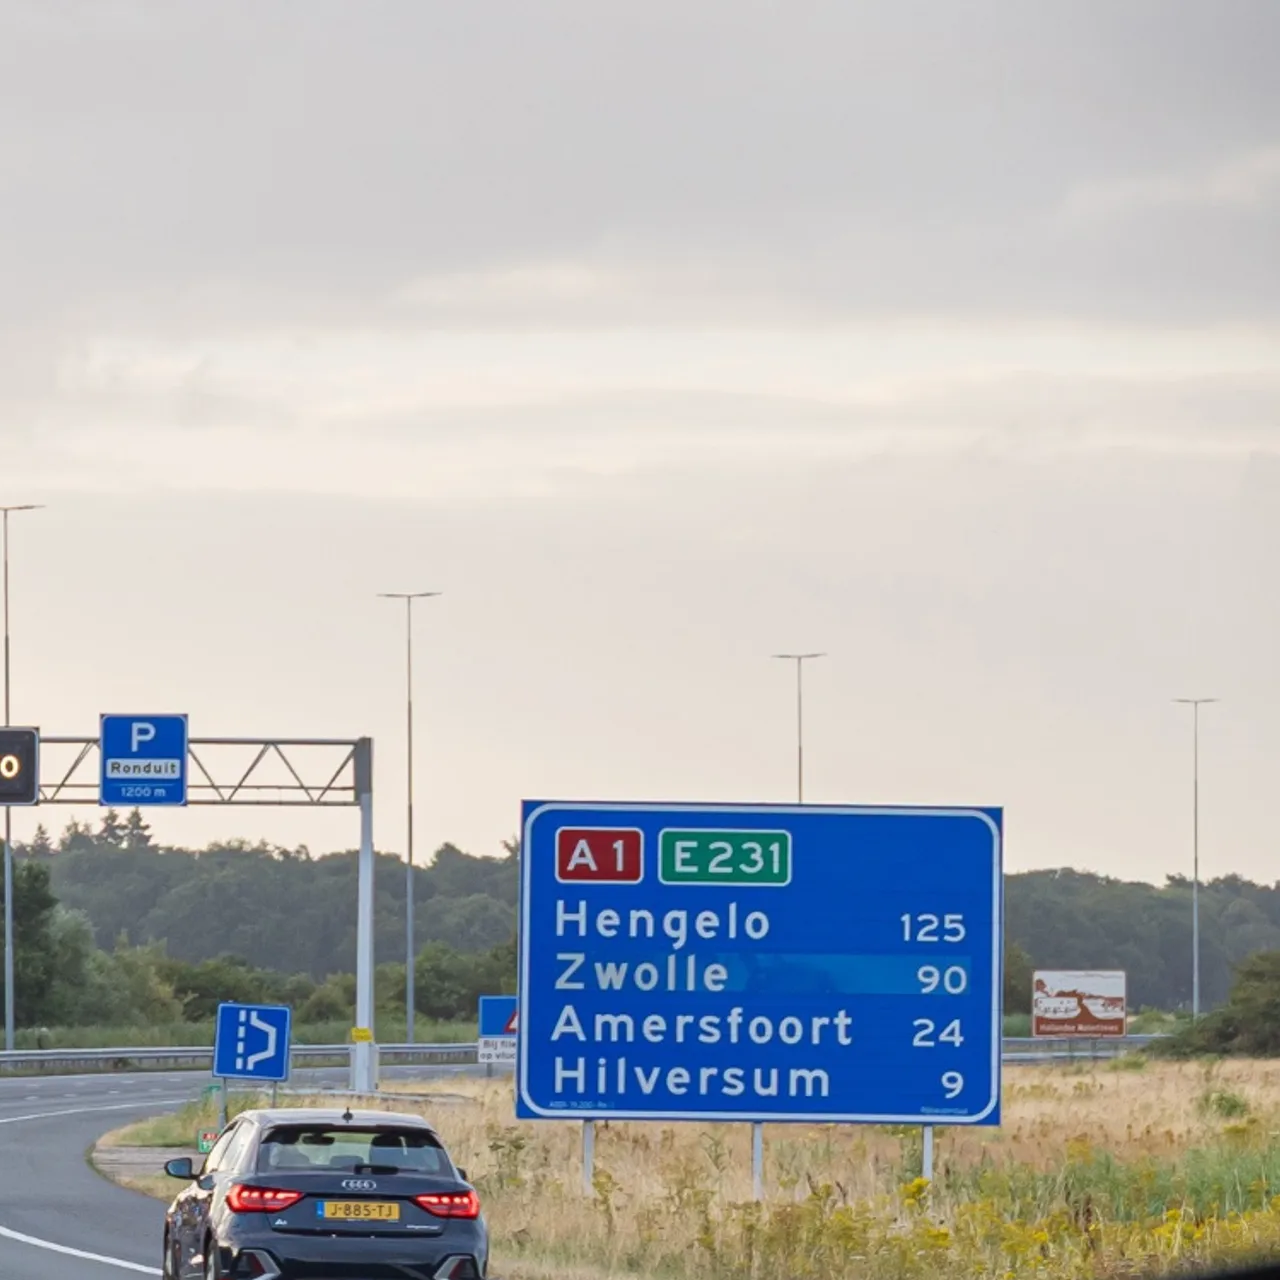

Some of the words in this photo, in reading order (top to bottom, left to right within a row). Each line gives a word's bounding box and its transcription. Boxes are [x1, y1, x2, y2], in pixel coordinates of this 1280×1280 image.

[131, 721, 157, 752] P
[110, 761, 177, 775] Ronduit
[120, 786, 151, 798] 1200
[153, 788, 167, 798] m
[566, 839, 625, 872] A1
[674, 841, 781, 874] E231
[555, 900, 770, 950] Hengelo
[900, 913, 967, 943] 125
[555, 953, 729, 991] Zwolle
[917, 965, 968, 995] 90
[550, 1004, 853, 1046] Amersfoort
[912, 1018, 965, 1048] 24
[554, 1057, 830, 1097] Hilversum
[941, 1071, 965, 1099] 9
[330, 1204, 393, 1216] J-885-TJ
